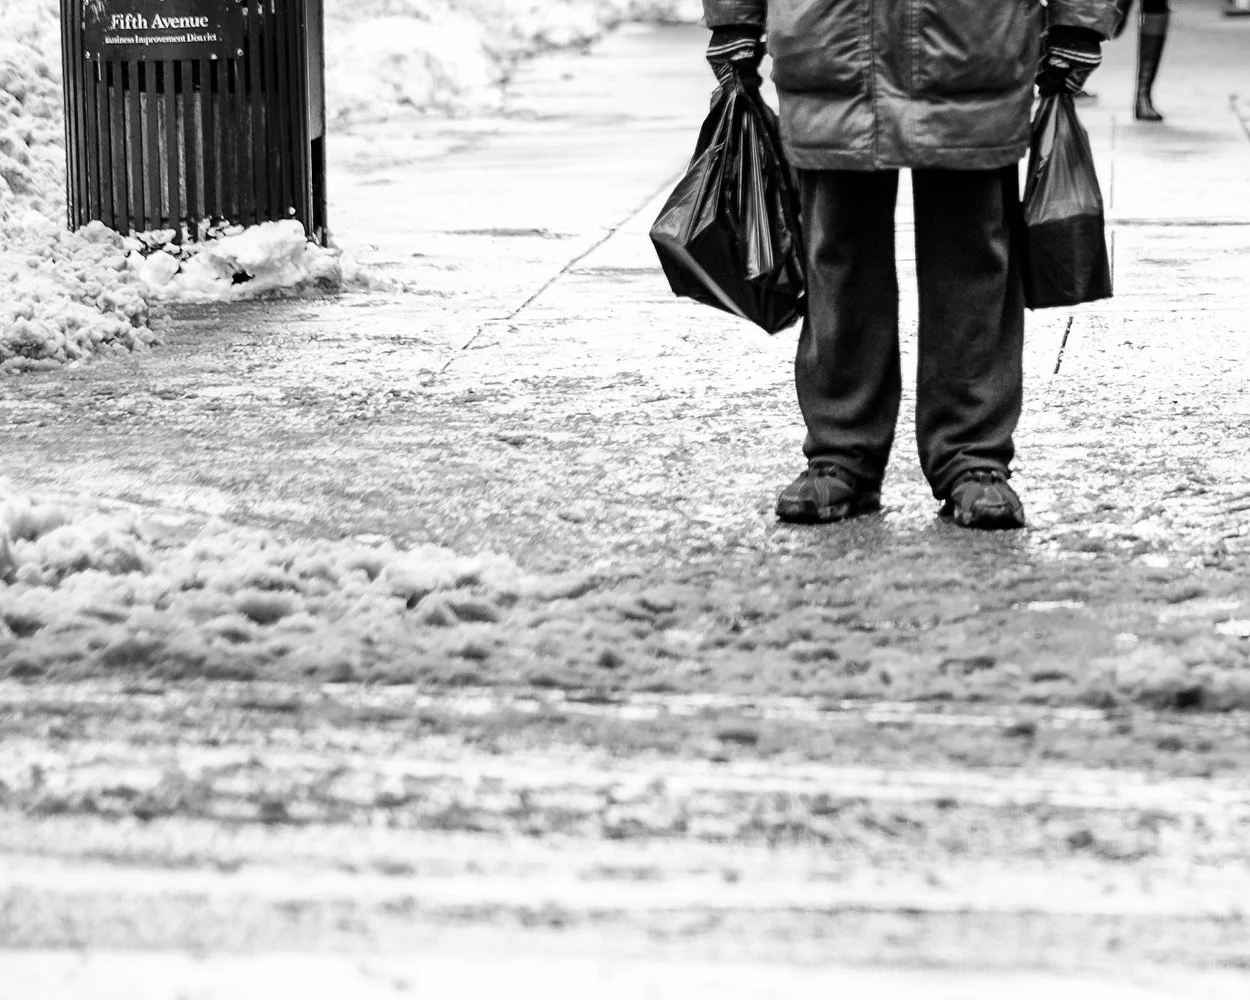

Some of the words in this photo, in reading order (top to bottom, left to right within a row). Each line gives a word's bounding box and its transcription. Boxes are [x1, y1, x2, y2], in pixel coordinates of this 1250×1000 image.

[111, 13, 148, 30] Fifth
[151, 13, 209, 30] Avenue
[105, 35, 134, 44] Business
[135, 34, 186, 46] Improvement
